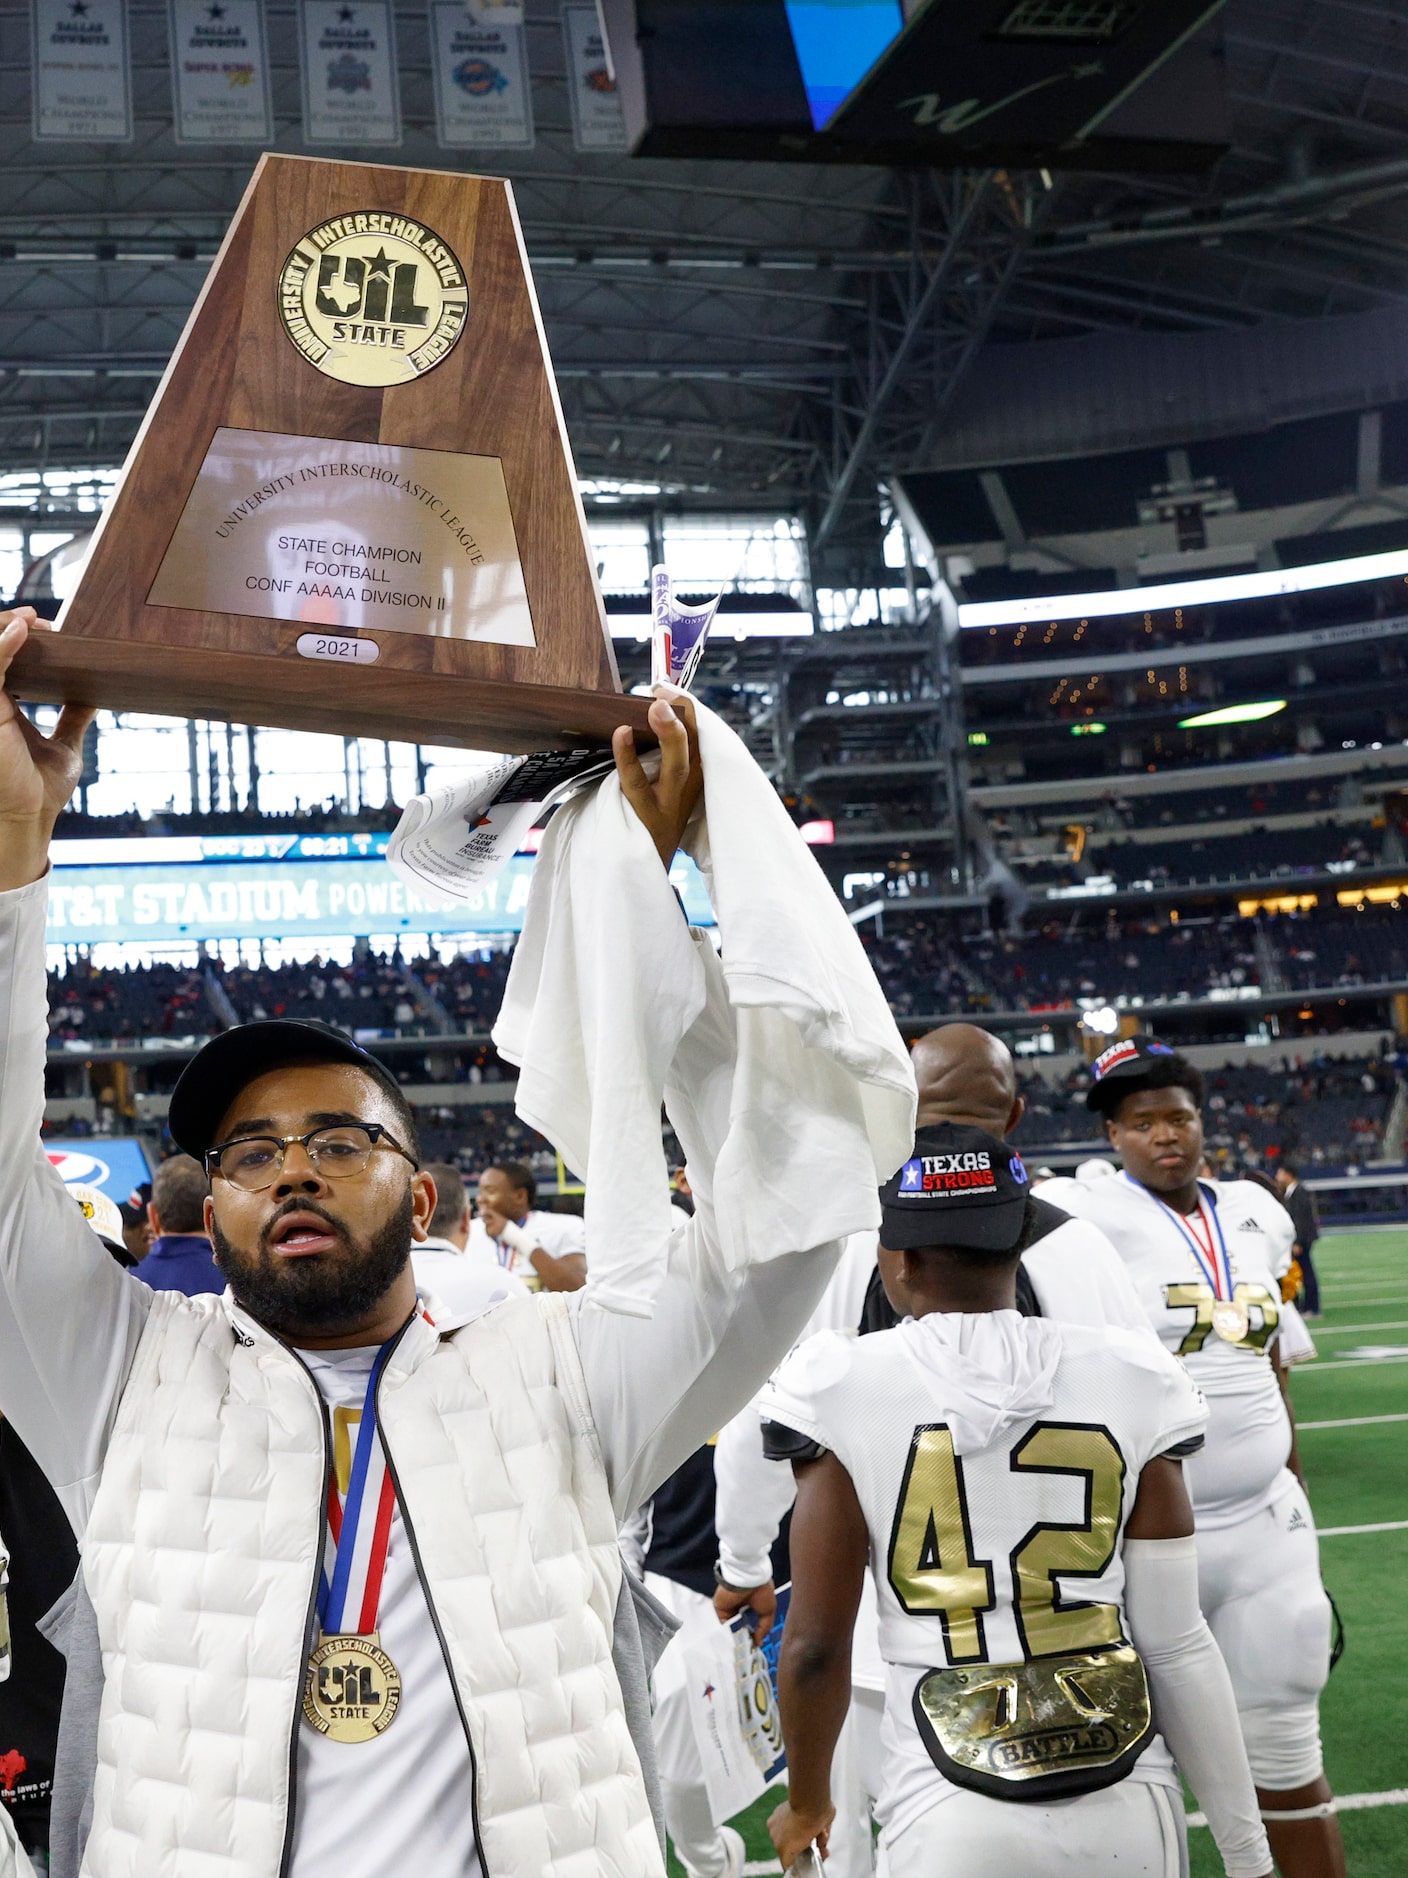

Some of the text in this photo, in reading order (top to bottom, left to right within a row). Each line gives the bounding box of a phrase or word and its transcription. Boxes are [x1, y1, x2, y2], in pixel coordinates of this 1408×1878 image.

[282, 213, 465, 371] UNIVERSITY INTERSCHOLASTIC LEAGUE
[333, 321, 407, 349] STATE
[215, 470, 297, 539] UNIVERSITY
[299, 462, 444, 513] INTERSCHOLASTIC
[439, 508, 486, 567] LEAGUE
[277, 536, 422, 565] STATE CHAMPION
[304, 560, 392, 584] FOOTBALL
[244, 575, 446, 611] CONF AAAAA DIVISION II
[315, 639, 361, 658] 2021
[465, 842, 496, 854] BUREAU
[470, 838, 493, 847] FARM
[475, 832, 499, 841] TEXAS
[458, 847, 502, 861] INSURANCE
[131, 878, 321, 925] STADIUM
[920, 1152, 991, 1175] TEXAS
[923, 1169, 995, 1191] STRONG
[886, 1420, 1127, 1666] 42
[312, 1639, 398, 1682] INTERSCHOLASTIC
[373, 1686, 400, 1731] LEAGUE
[318, 1664, 381, 1706] UIL
[329, 1706, 371, 1720] STATE
[1000, 1728, 1108, 1766] BATTLE
[0, 1779, 51, 1798] the laws of
